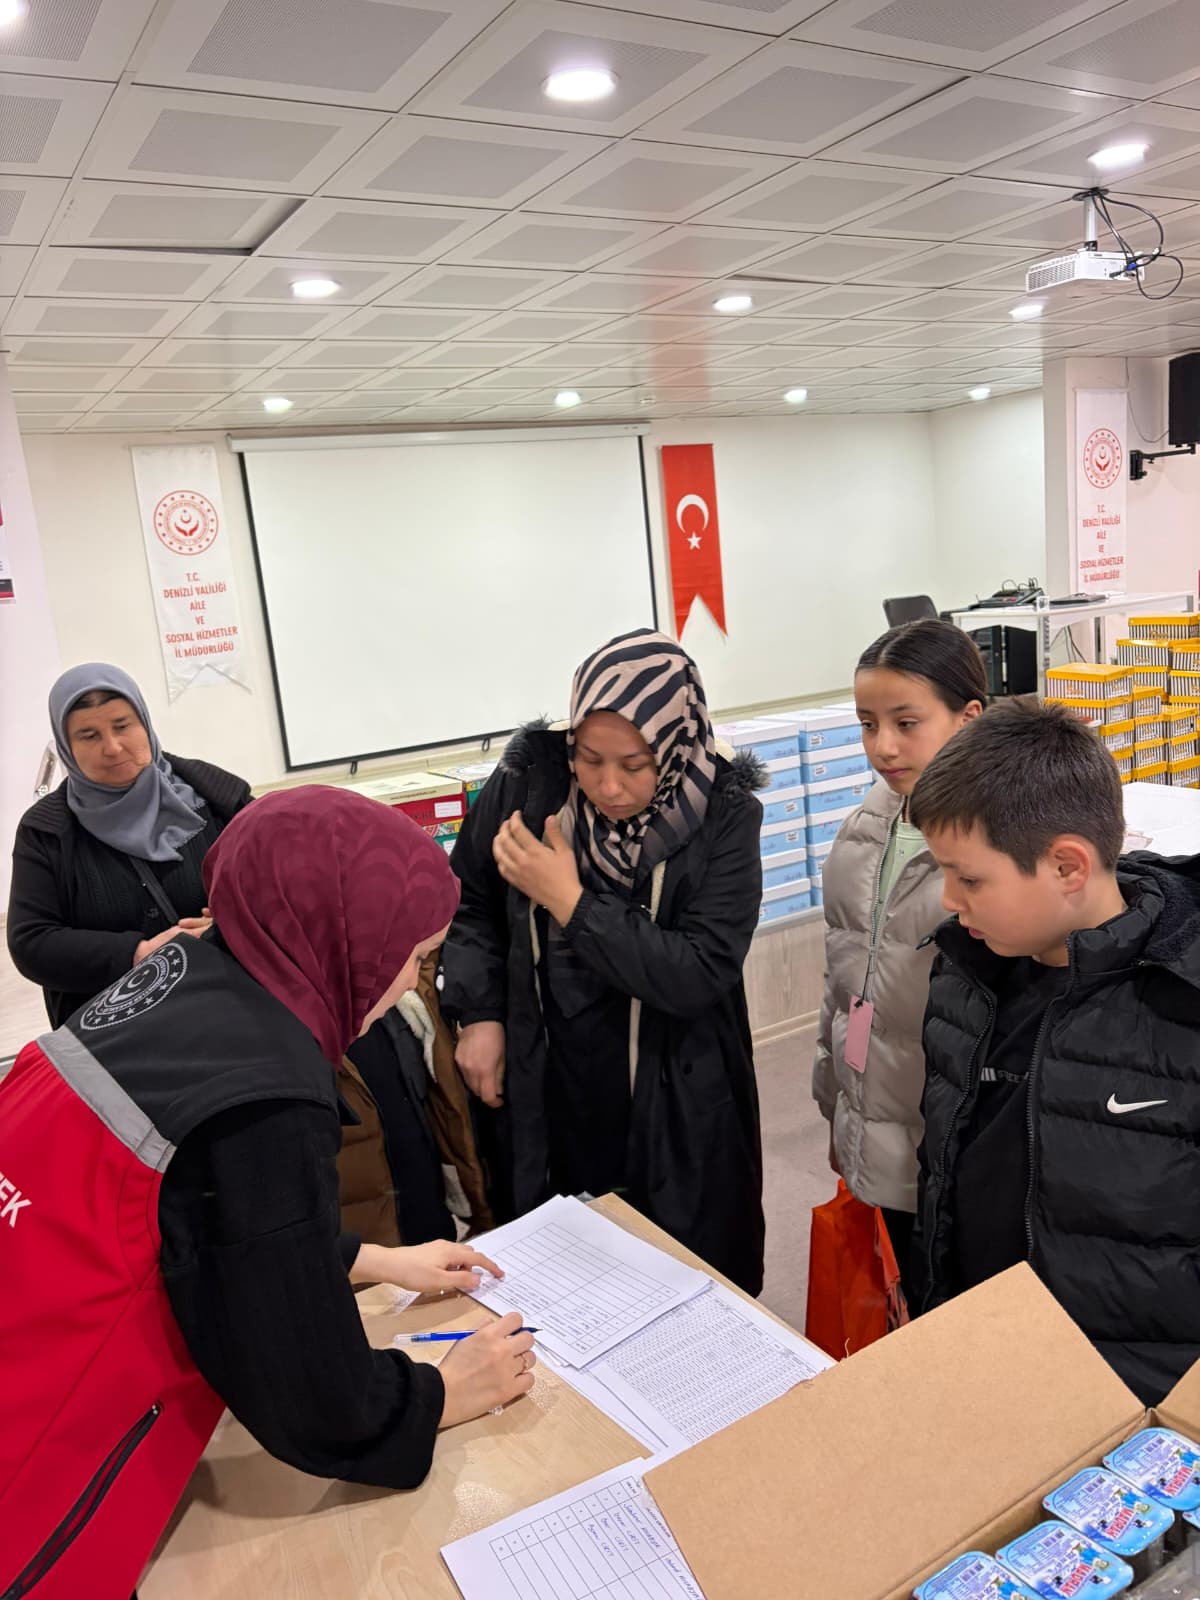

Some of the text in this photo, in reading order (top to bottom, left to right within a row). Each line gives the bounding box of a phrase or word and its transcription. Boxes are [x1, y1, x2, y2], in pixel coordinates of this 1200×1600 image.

[186, 572, 200, 582] T.C.
[163, 581, 226, 598] DENİZLİ VALİLİĞİ
[190, 601, 206, 611] AİLE
[195, 616, 205, 625] VE
[166, 626, 238, 643] SOSYAL HİZMETLER
[175, 642, 234, 658] İL MÜDÜRLÜĞÜ
[0, 1171, 32, 1228] EK
